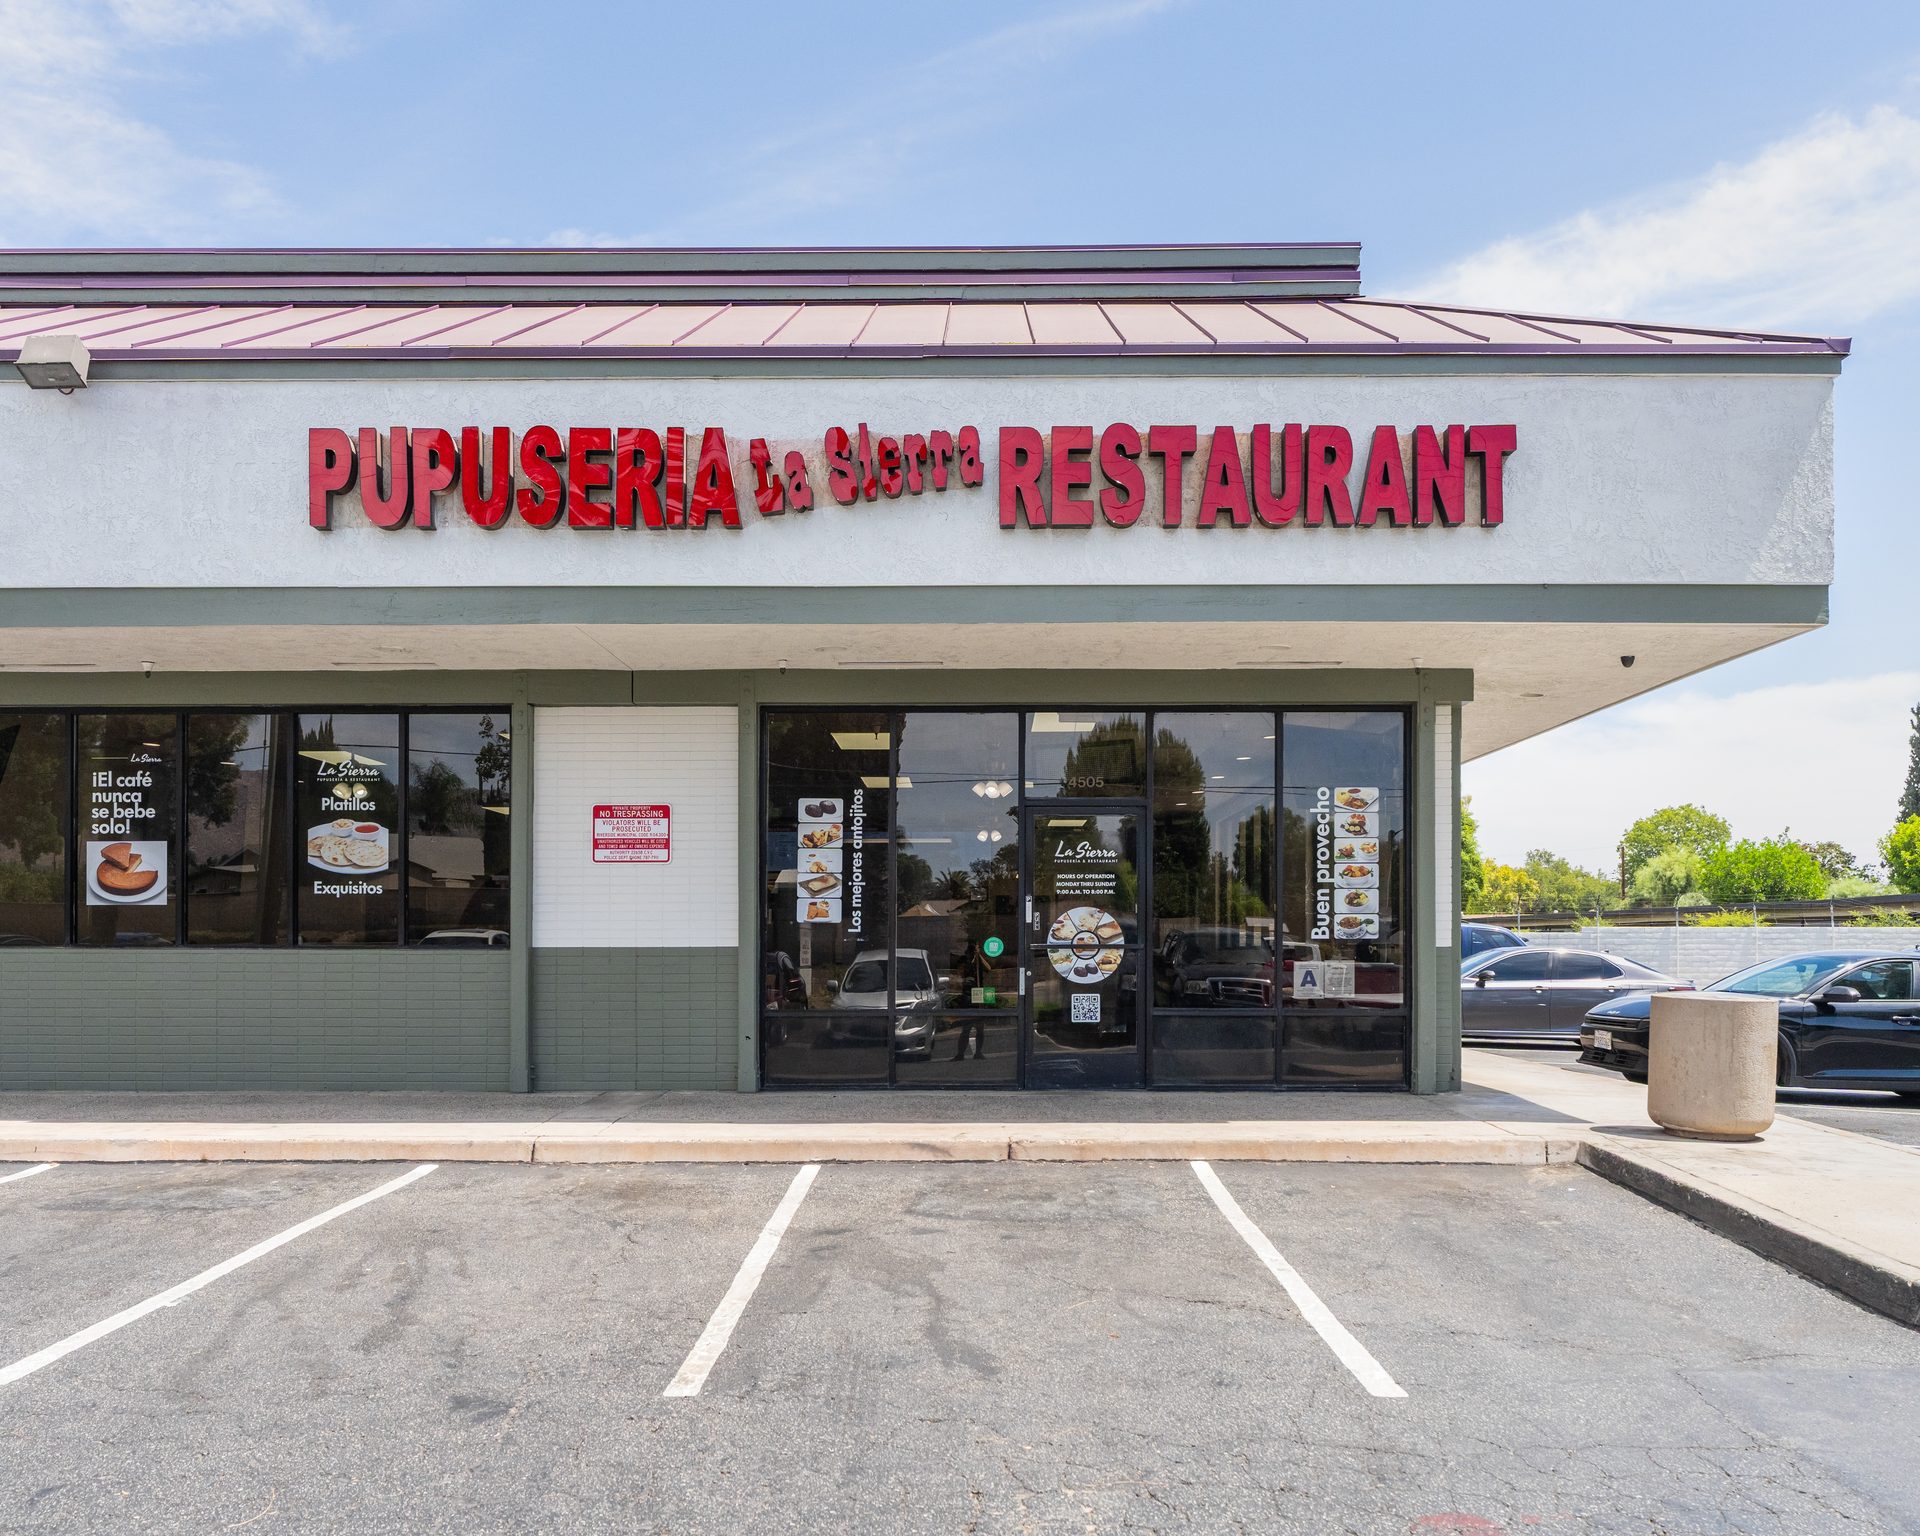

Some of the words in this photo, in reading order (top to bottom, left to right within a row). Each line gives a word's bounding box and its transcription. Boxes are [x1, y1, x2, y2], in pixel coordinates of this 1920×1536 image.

[308, 426, 742, 531] PUPUSERIA
[749, 437, 814, 516] La
[823, 421, 984, 506] Sierra
[999, 422, 1518, 529] RESTAURANT
[130, 753, 141, 762] La
[141, 753, 162, 763] Sierra
[317, 760, 337, 777] La
[337, 759, 380, 777] Sierra
[116, 770, 152, 787] café
[1068, 776, 1105, 788] 4505
[92, 792, 142, 803] nunca
[321, 797, 376, 812] Platillos
[91, 807, 110, 819] se
[113, 802, 156, 819] bebe
[599, 810, 611, 818] NO
[613, 810, 664, 818] TRESPASSING
[849, 788, 867, 850] antojitos
[91, 817, 131, 835] solo!
[1310, 786, 1334, 883] provecho
[1055, 840, 1075, 857] La
[1075, 841, 1118, 858] Sierra
[848, 851, 866, 907] mejores
[313, 881, 383, 898] Exquisitos
[847, 910, 862, 933] Los
[1311, 888, 1330, 940] Buen
[1300, 970, 1317, 987] A
